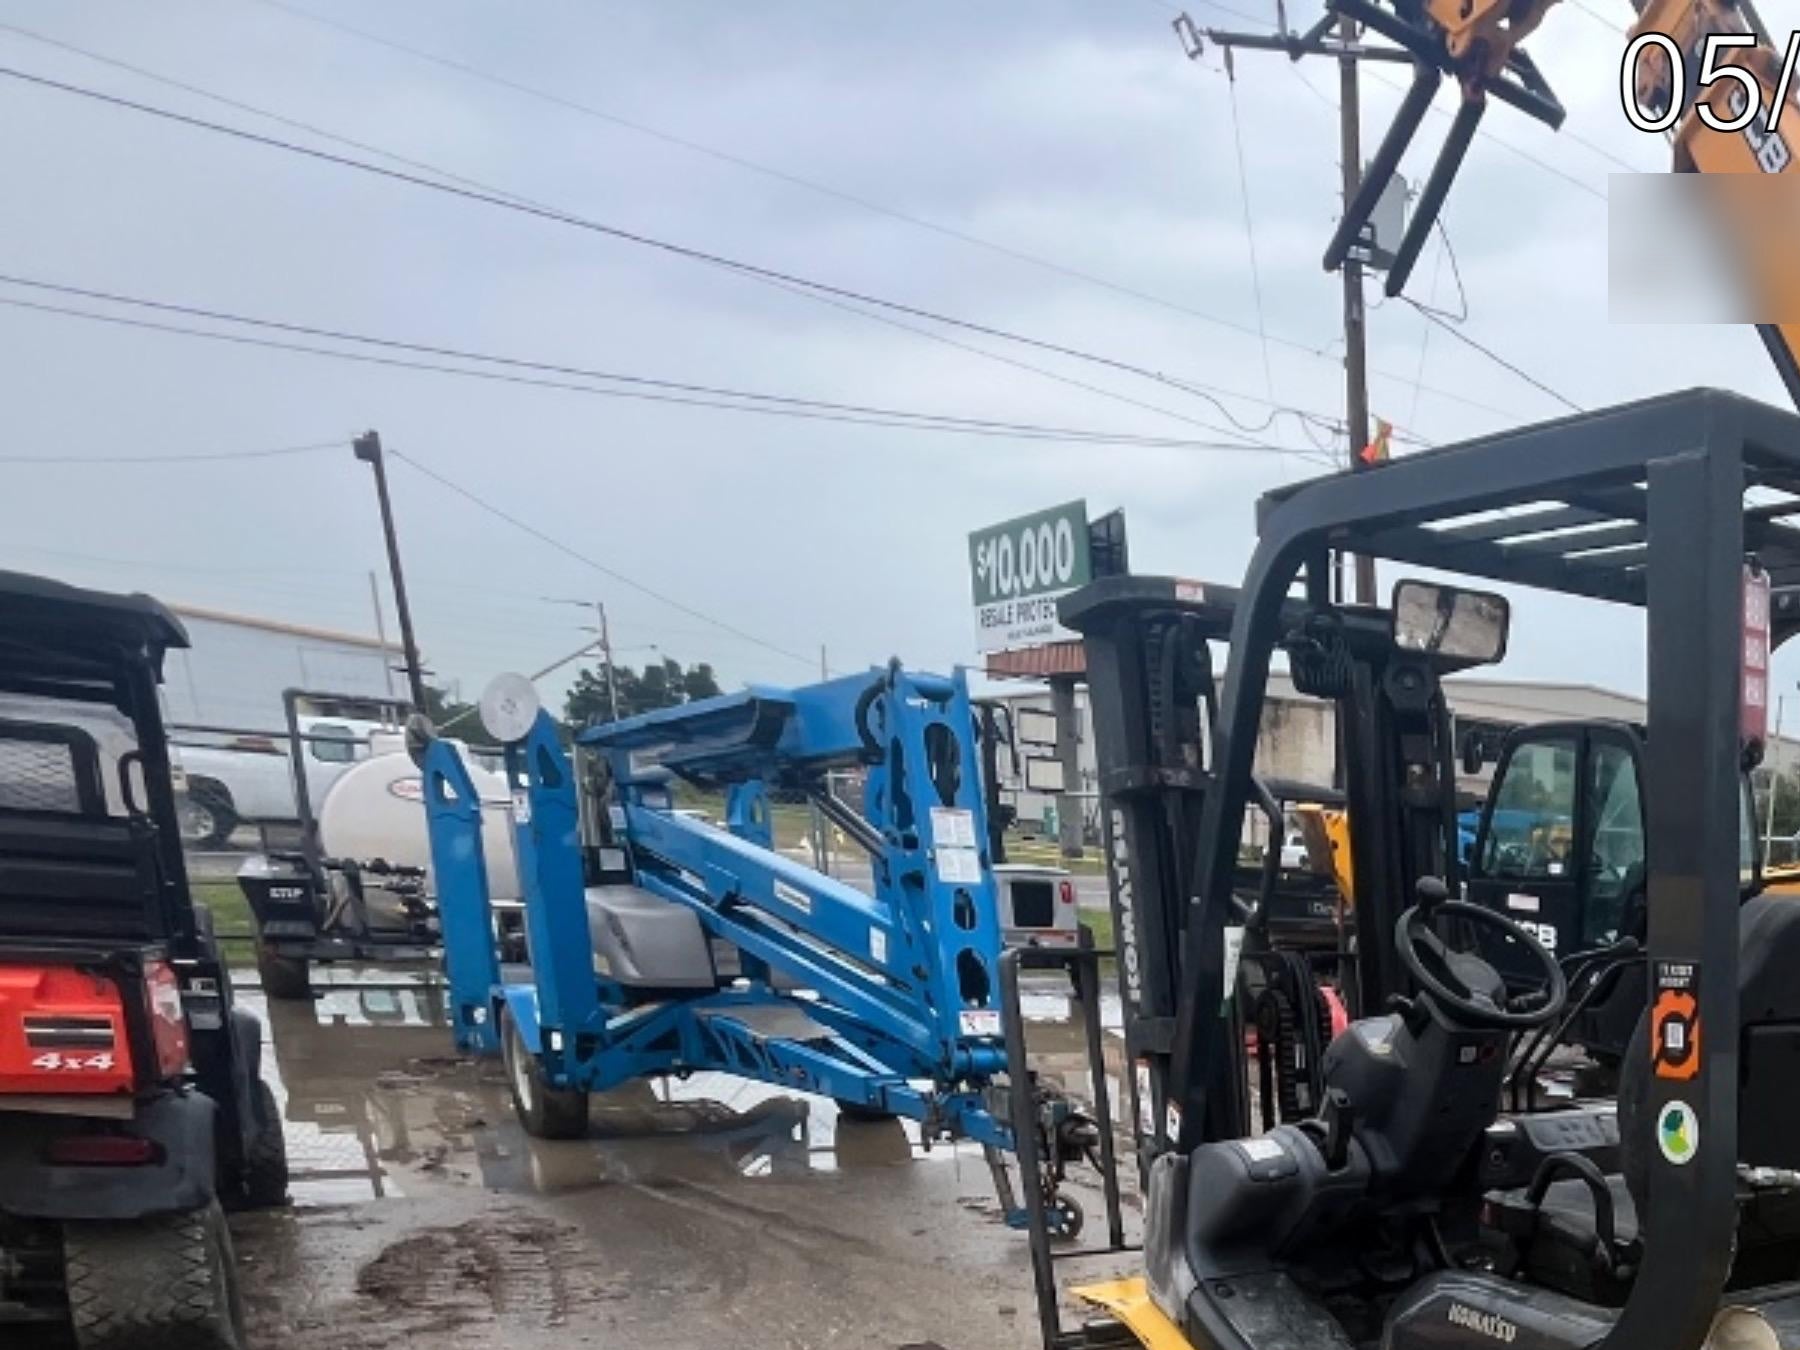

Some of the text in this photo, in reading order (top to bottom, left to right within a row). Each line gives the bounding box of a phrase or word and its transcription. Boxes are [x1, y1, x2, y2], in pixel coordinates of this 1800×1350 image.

[976, 516, 1075, 598] $10,000
[980, 603, 1013, 629] RESALE
[1111, 808, 1142, 1001] KOMATSU
[32, 1051, 116, 1070] 4x4
[1448, 1301, 1518, 1343] KOMATSU
